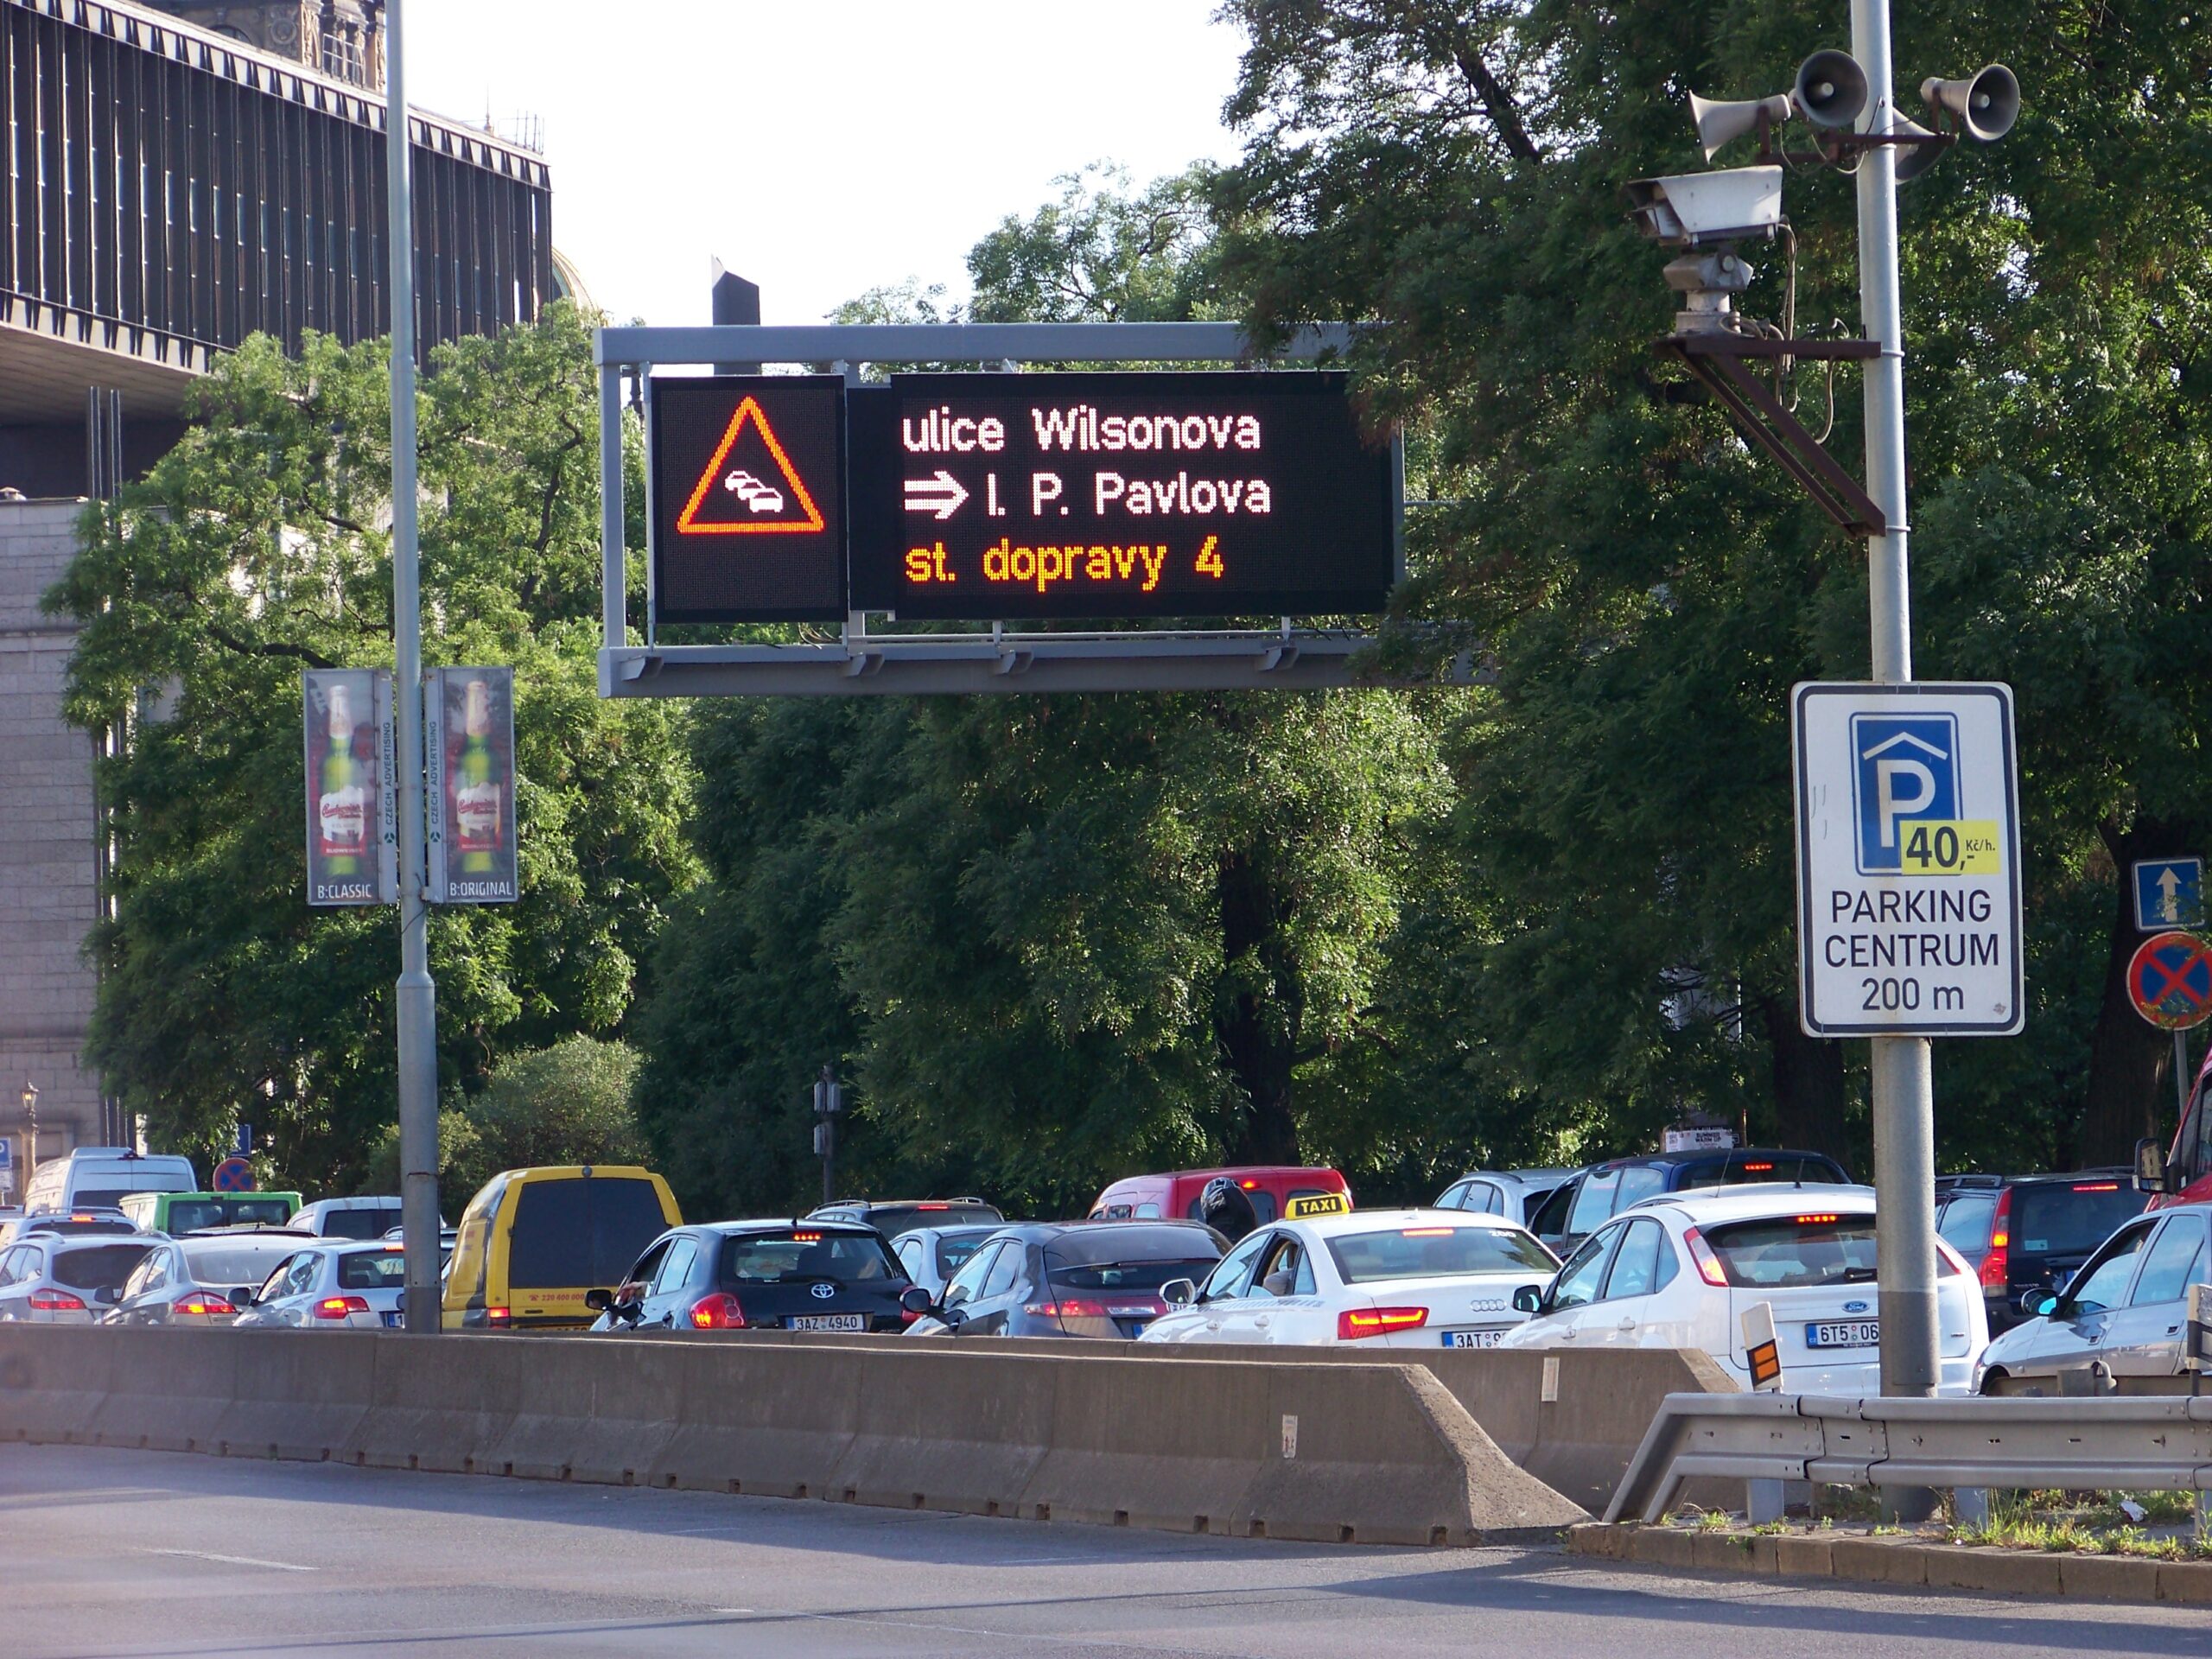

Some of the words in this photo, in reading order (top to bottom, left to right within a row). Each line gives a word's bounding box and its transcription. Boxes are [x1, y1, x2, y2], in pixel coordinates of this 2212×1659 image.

[903, 406, 1004, 452] ulice
[1032, 405, 1262, 451] Wilsonova
[1033, 473, 1069, 516] P.
[1095, 472, 1271, 516] Pavlova
[906, 542, 956, 582] st.
[983, 537, 1166, 592] dopravy
[1196, 536, 1224, 578] 4
[429, 721, 438, 786] ADVERTISING
[1876, 759, 1936, 848] P
[317, 884, 372, 899] B:CLASSIC
[449, 881, 512, 897] B:ORIGINAL
[1832, 889, 1991, 923] PARKING
[1825, 933, 1999, 968] CENTRUM
[1862, 978, 1920, 1011] 200
[1934, 986, 1964, 1010] m
[1301, 1198, 1337, 1213] TAXI
[797, 1318, 818, 1330] 3AZ
[829, 1316, 857, 1329] 4940
[1821, 1325, 1848, 1342] 6T5
[1457, 1333, 1481, 1348] 3AT
